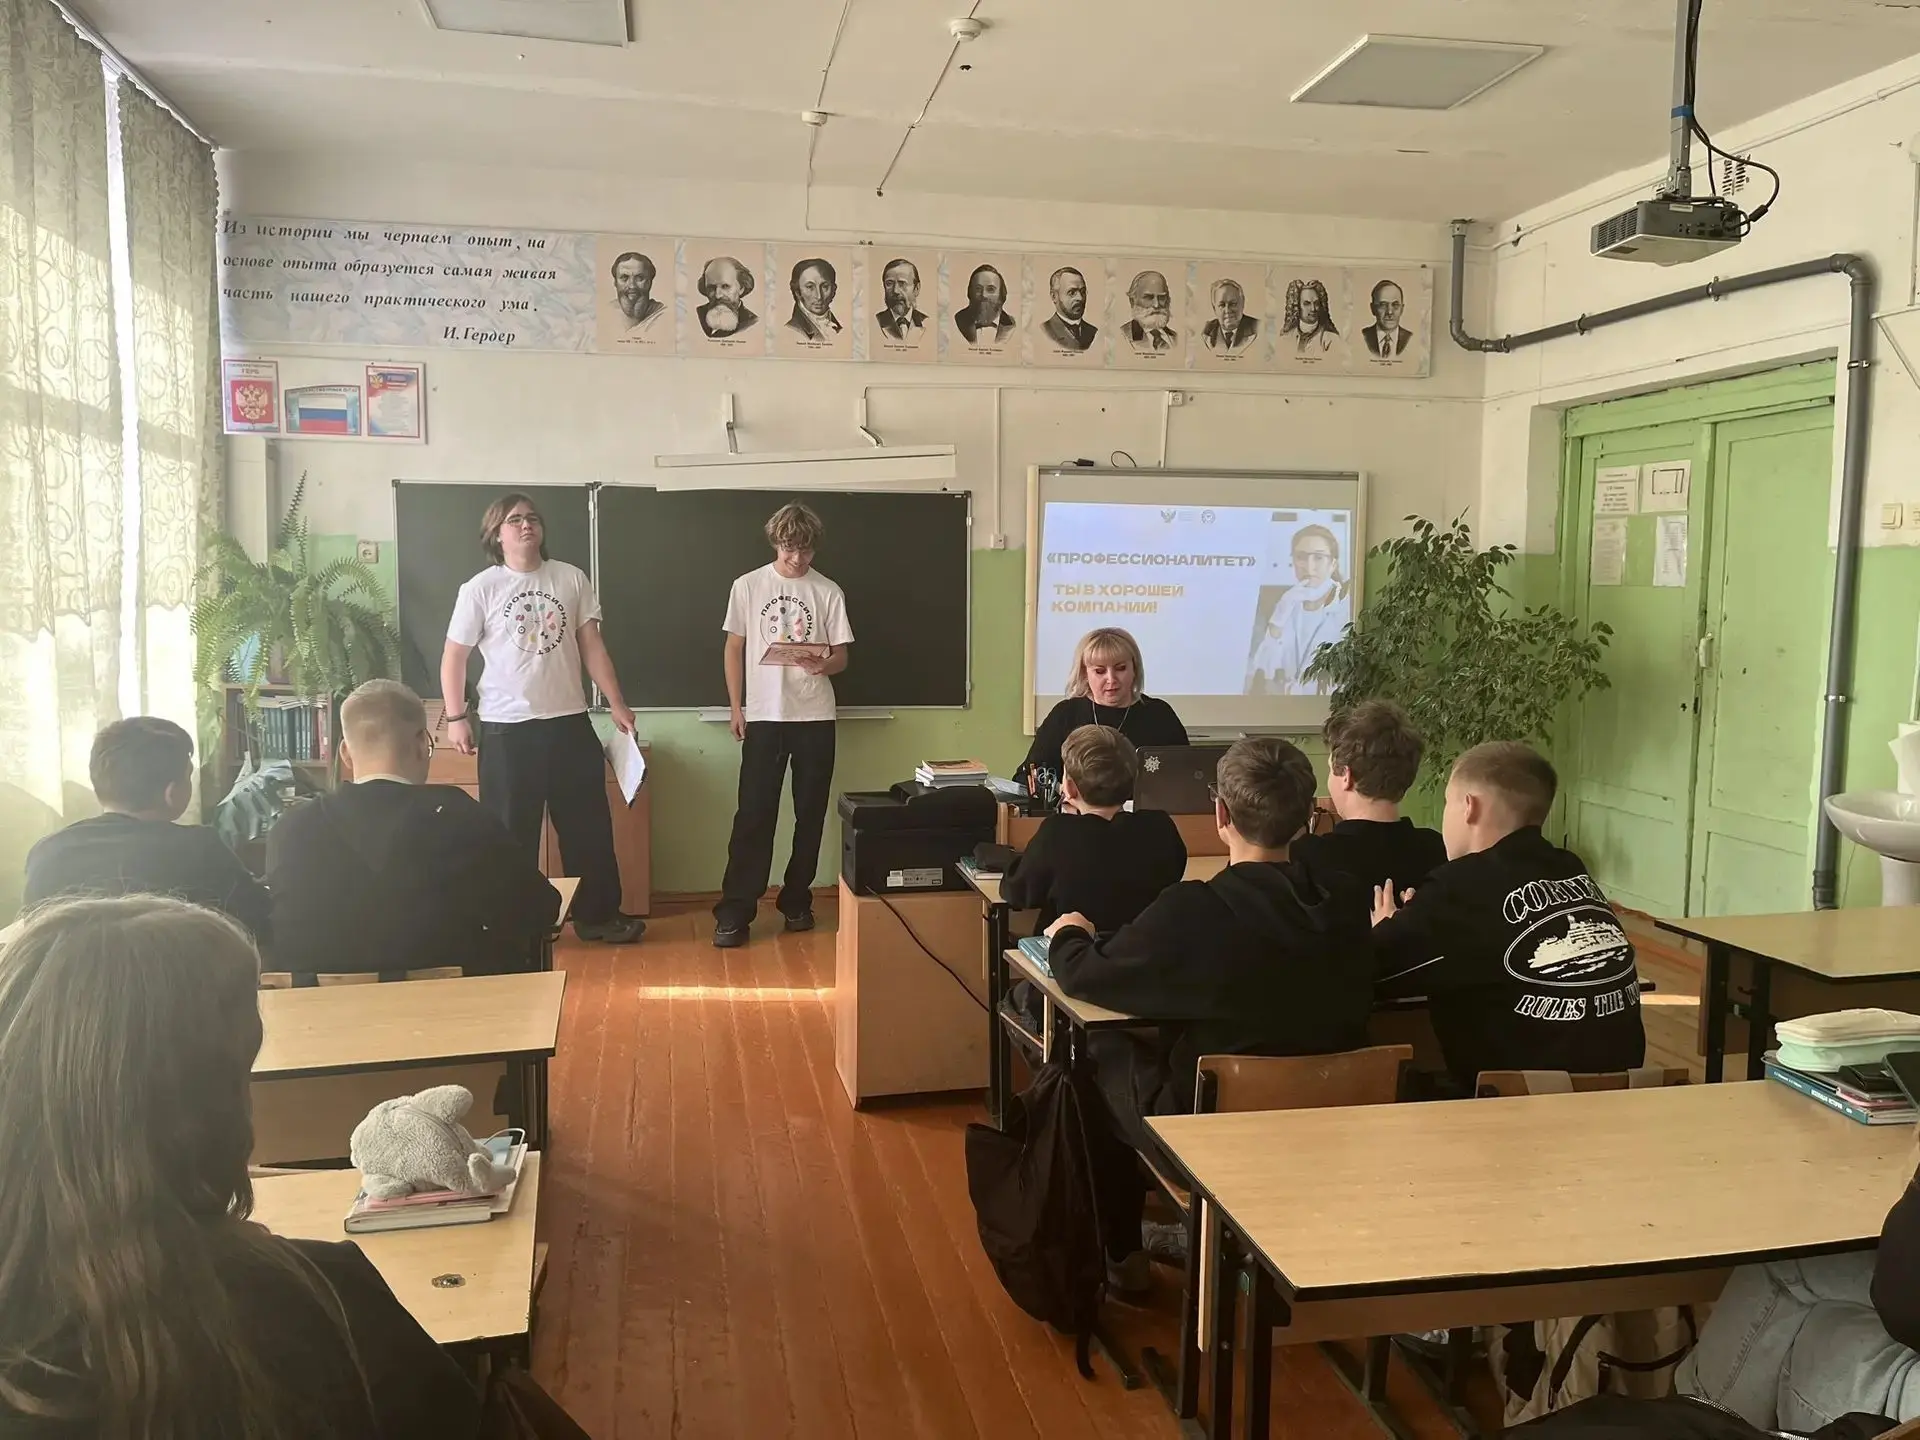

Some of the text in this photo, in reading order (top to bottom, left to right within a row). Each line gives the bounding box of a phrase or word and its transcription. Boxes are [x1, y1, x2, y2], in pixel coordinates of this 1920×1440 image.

[223, 220, 546, 250] Из истории мы черпаем опыт, на
[223, 256, 557, 280] основе опыта образуется самая живая
[223, 287, 538, 312] часть нашего практического ума.
[1046, 552, 1257, 567] «ПРОФЕССИОНАЛИТЕТ»
[1053, 583, 1184, 597] ТЫ В ХОРОШЕЙ
[1051, 601, 1158, 614] КОМПАНИИ!
[503, 590, 567, 656] ПРОФЕССИОНАЛИТЕТ
[1514, 994, 1586, 1020] RULES
[1594, 989, 1625, 1017] THE
